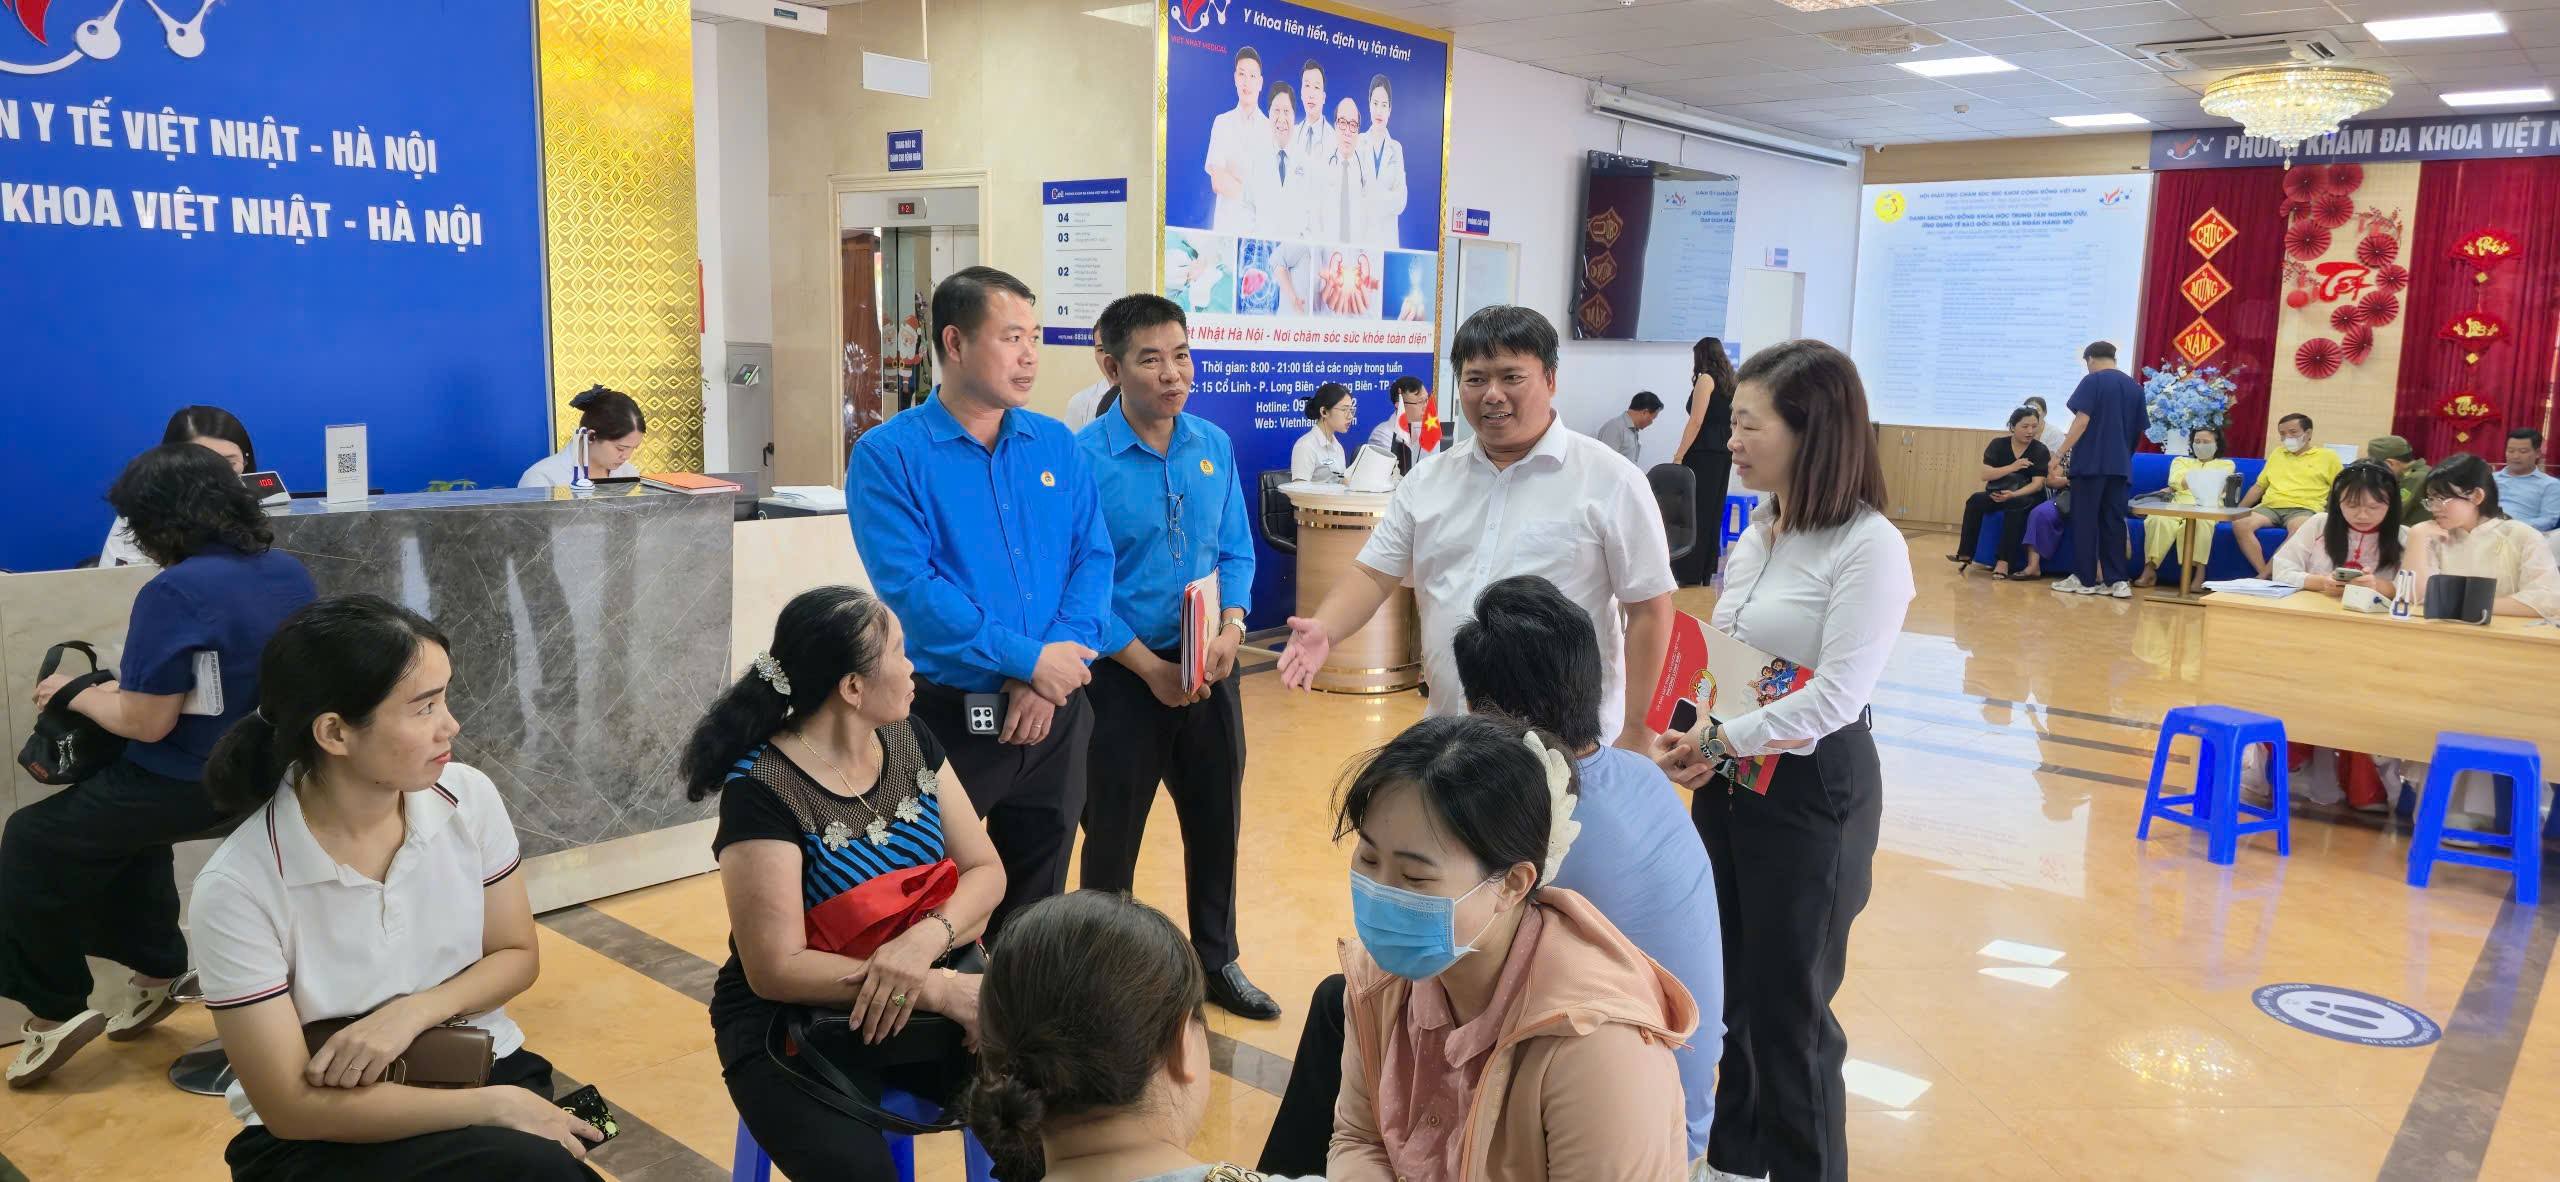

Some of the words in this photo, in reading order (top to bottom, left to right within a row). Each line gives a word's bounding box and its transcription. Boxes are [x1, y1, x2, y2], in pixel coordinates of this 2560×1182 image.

[1244, 8, 1251, 23] Y
[1253, 11, 1281, 31] khoa
[1284, 18, 1304, 37] tiên
[1307, 24, 1329, 44] tiến,
[1332, 32, 1355, 49] dịch
[1358, 39, 1369, 55] vụ
[1371, 41, 1387, 58] tận
[1389, 45, 1411, 61] tâm!
[31, 102, 55, 142] Y
[66, 96, 113, 148] TẾ
[122, 106, 199, 161] VIỆT
[210, 115, 300, 169] NHẬT
[309, 144, 322, 153] -
[333, 125, 376, 168] HÀ
[385, 130, 437, 180] NỘI
[2380, 127, 2411, 152] ĐA
[2418, 124, 2482, 151] KHOA
[2492, 116, 2545, 153] VIỆT
[2, 182, 122, 227] KHOA
[132, 185, 218, 239] VIỆT
[232, 193, 331, 245] NHẬT
[344, 219, 357, 229] -
[368, 200, 416, 243] HÀ
[425, 203, 482, 253] NỘI
[1058, 213, 1069, 222] 04
[1058, 233, 1069, 242] 03
[2196, 217, 2224, 249] CHÚC
[1058, 267, 1069, 276] 02
[2190, 271, 2218, 303] MỪNG
[1058, 306, 1068, 315] 01
[1199, 326, 1225, 343] Nhật
[1228, 326, 1242, 341] Hà
[1246, 327, 1264, 344] Nội
[1273, 328, 1291, 342] Nơi
[1293, 329, 1320, 343] chăm
[1323, 329, 1341, 343] sóc
[1343, 331, 1360, 344] sức
[1363, 330, 1385, 344] khỏe
[1387, 331, 1406, 345] toàn
[1201, 360, 1223, 373] Thời
[1225, 361, 1248, 376] gian:
[1250, 361, 1270, 373] 8:00
[1277, 362, 1300, 373] 21:00
[1302, 361, 1313, 373] tất
[1315, 361, 1325, 373] cả
[1327, 362, 1341, 373] các
[1343, 362, 1363, 376] ngày
[1364, 362, 1385, 376] trong
[1386, 360, 1403, 373] tuần
[1202, 381, 1213, 393] 15
[1215, 378, 1229, 393] Cổ
[1230, 381, 1251, 393] Linh
[1259, 381, 1269, 393] P.
[1270, 381, 1293, 395] Long
[1294, 381, 1314, 393] Biên
[1355, 380, 1373, 392] Biên
[1256, 401, 1290, 413] Hotline:
[1255, 417, 1278, 429] Web:
